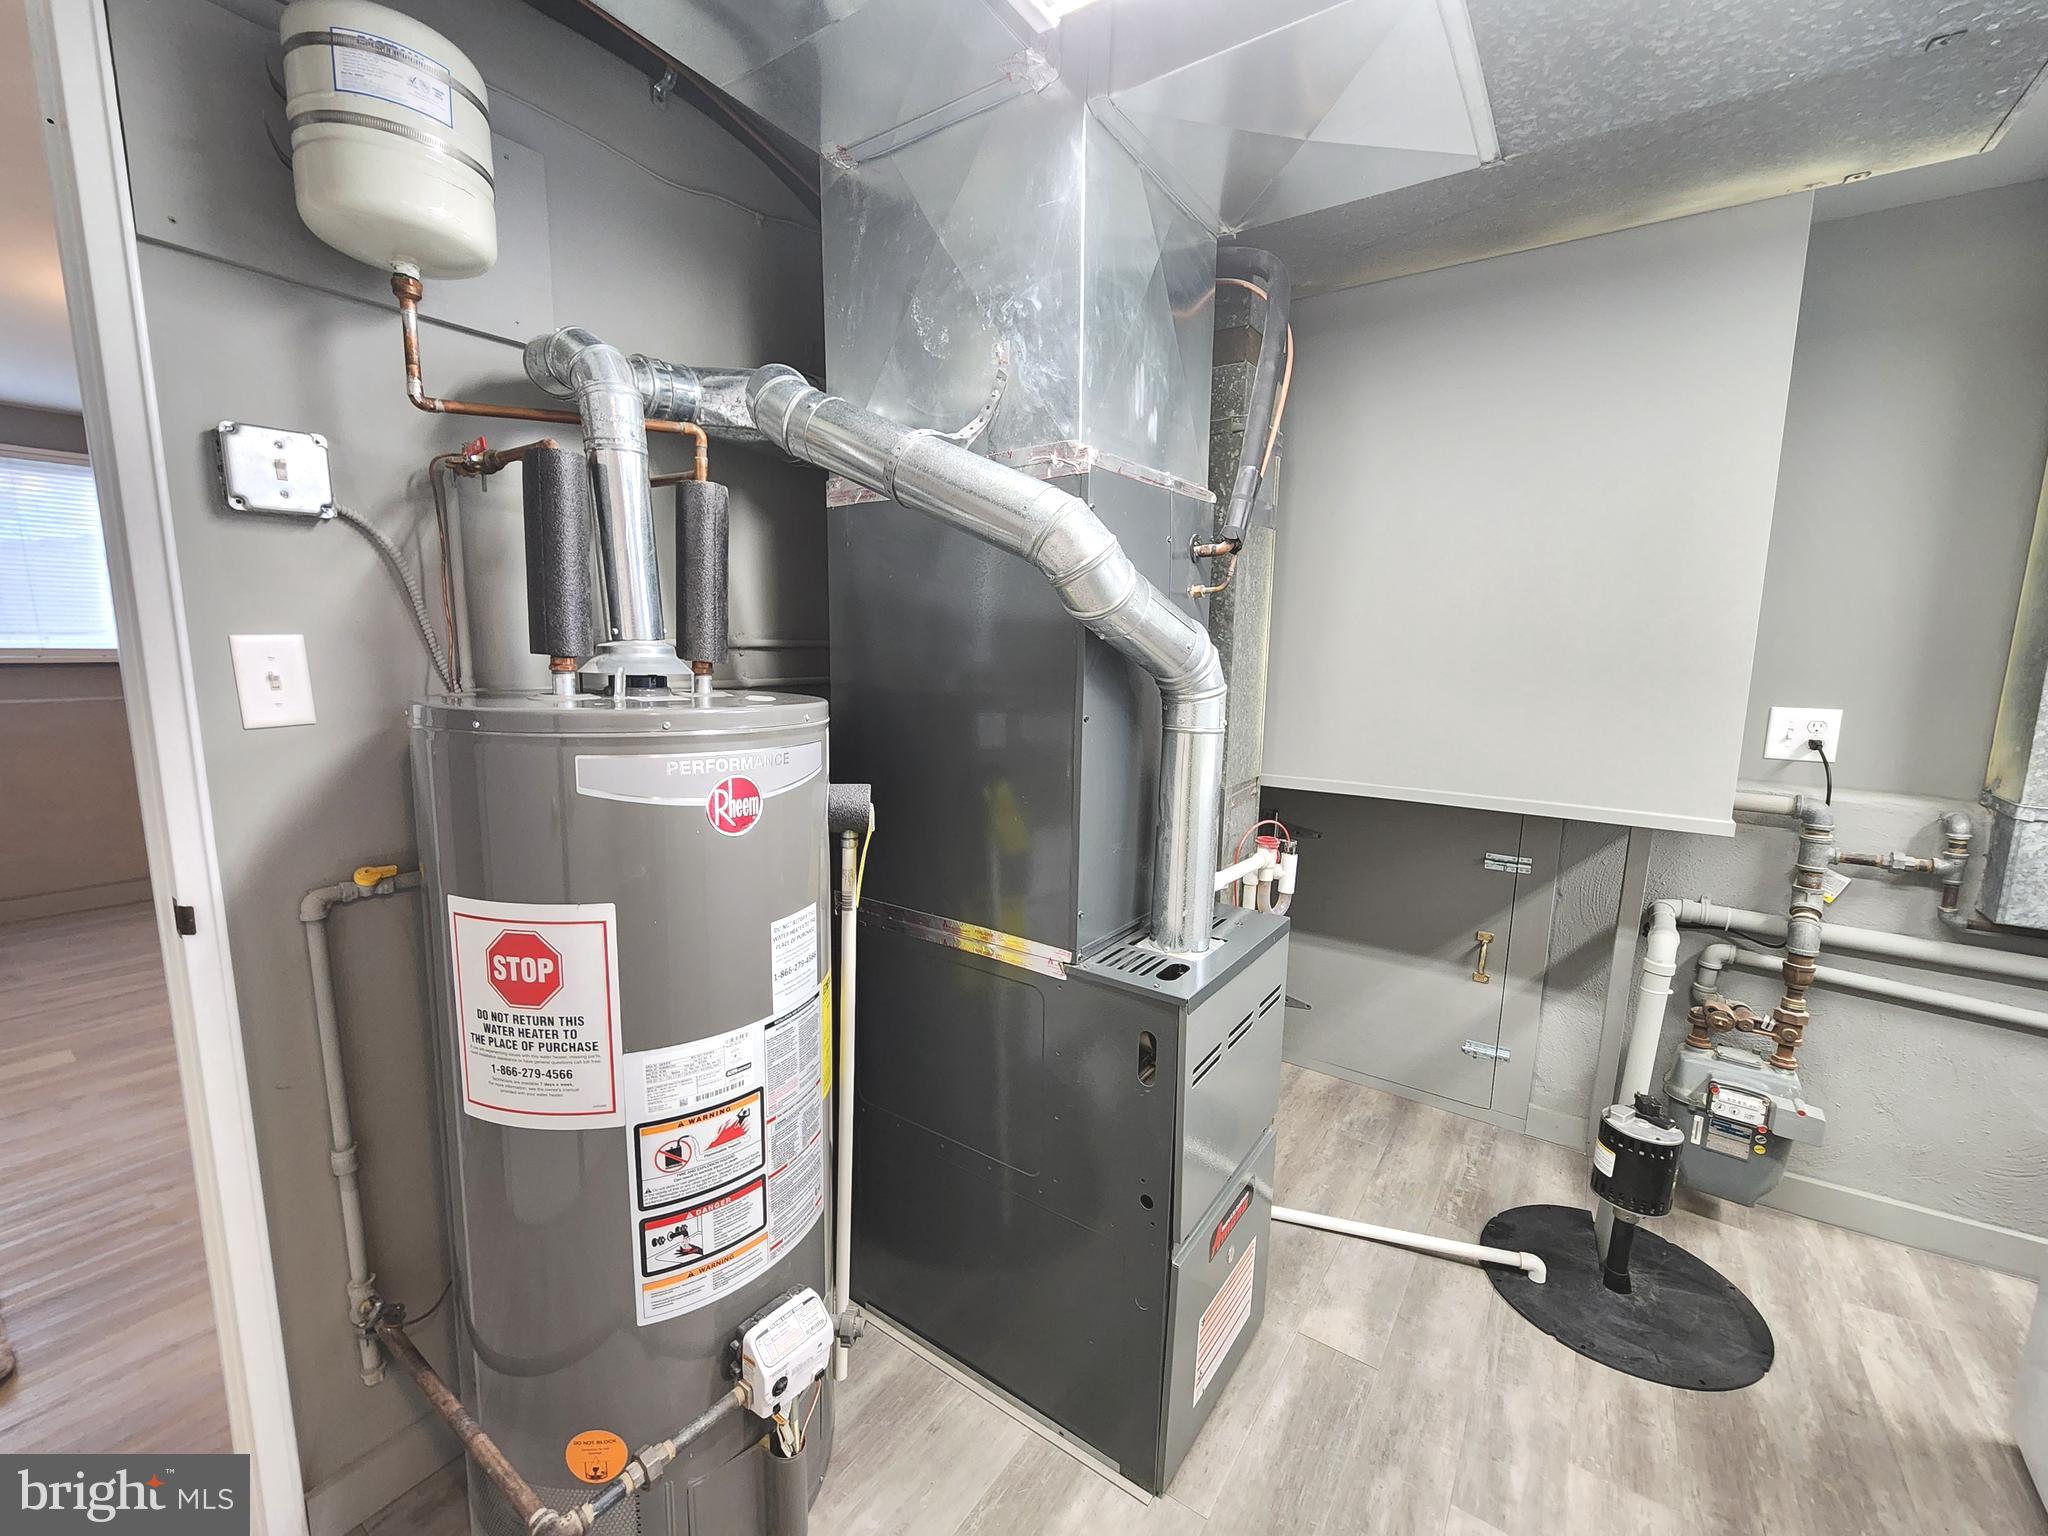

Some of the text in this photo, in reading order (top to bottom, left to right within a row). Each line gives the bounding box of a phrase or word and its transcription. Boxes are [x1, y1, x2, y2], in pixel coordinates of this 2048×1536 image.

[667, 752, 790, 776] PERFORMANCE
[714, 777, 760, 826] Rheem
[492, 954, 554, 983] STOP
[476, 1008, 585, 1027] DO NOT RETURN THIS
[483, 1022, 578, 1040] WATER HEATER TO
[470, 1032, 486, 1046] THE
[488, 1037, 518, 1051] PLACE
[521, 1040, 535, 1052] OF
[538, 1041, 599, 1053] PURCHASE
[490, 1063, 574, 1080] 1-866-279-4566
[688, 1106, 732, 1125] WARNING
[695, 1197, 732, 1216] DANGER
[698, 1254, 735, 1274] WARNING
